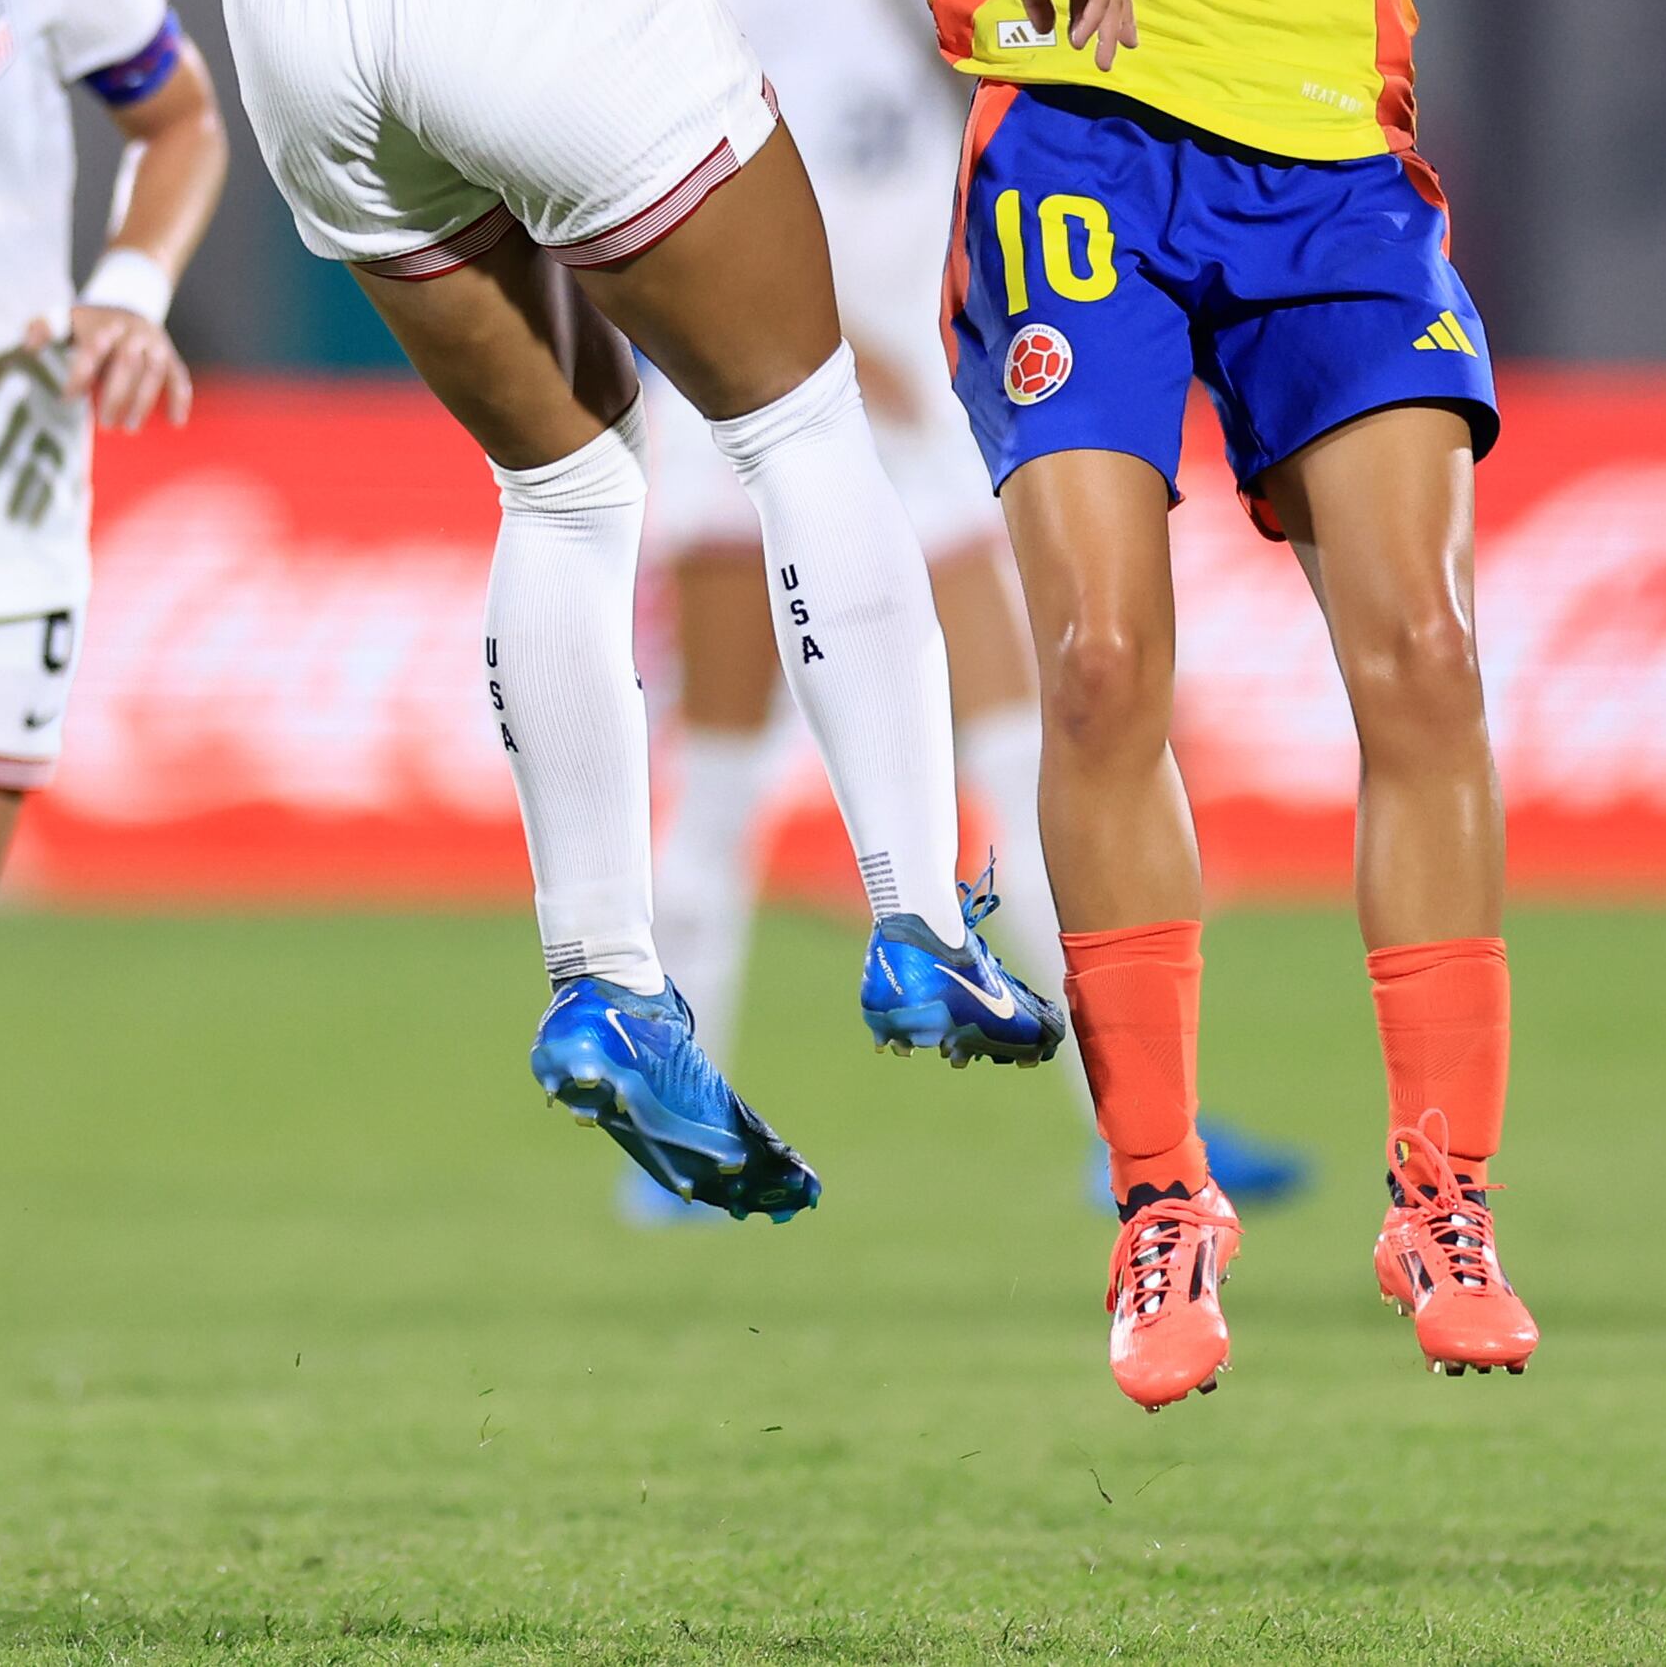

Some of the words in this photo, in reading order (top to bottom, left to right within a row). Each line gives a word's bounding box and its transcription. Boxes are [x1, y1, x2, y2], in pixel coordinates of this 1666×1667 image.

[993, 189, 1119, 317] 10
[781, 565, 824, 665] USA
[485, 636, 519, 754] USA
